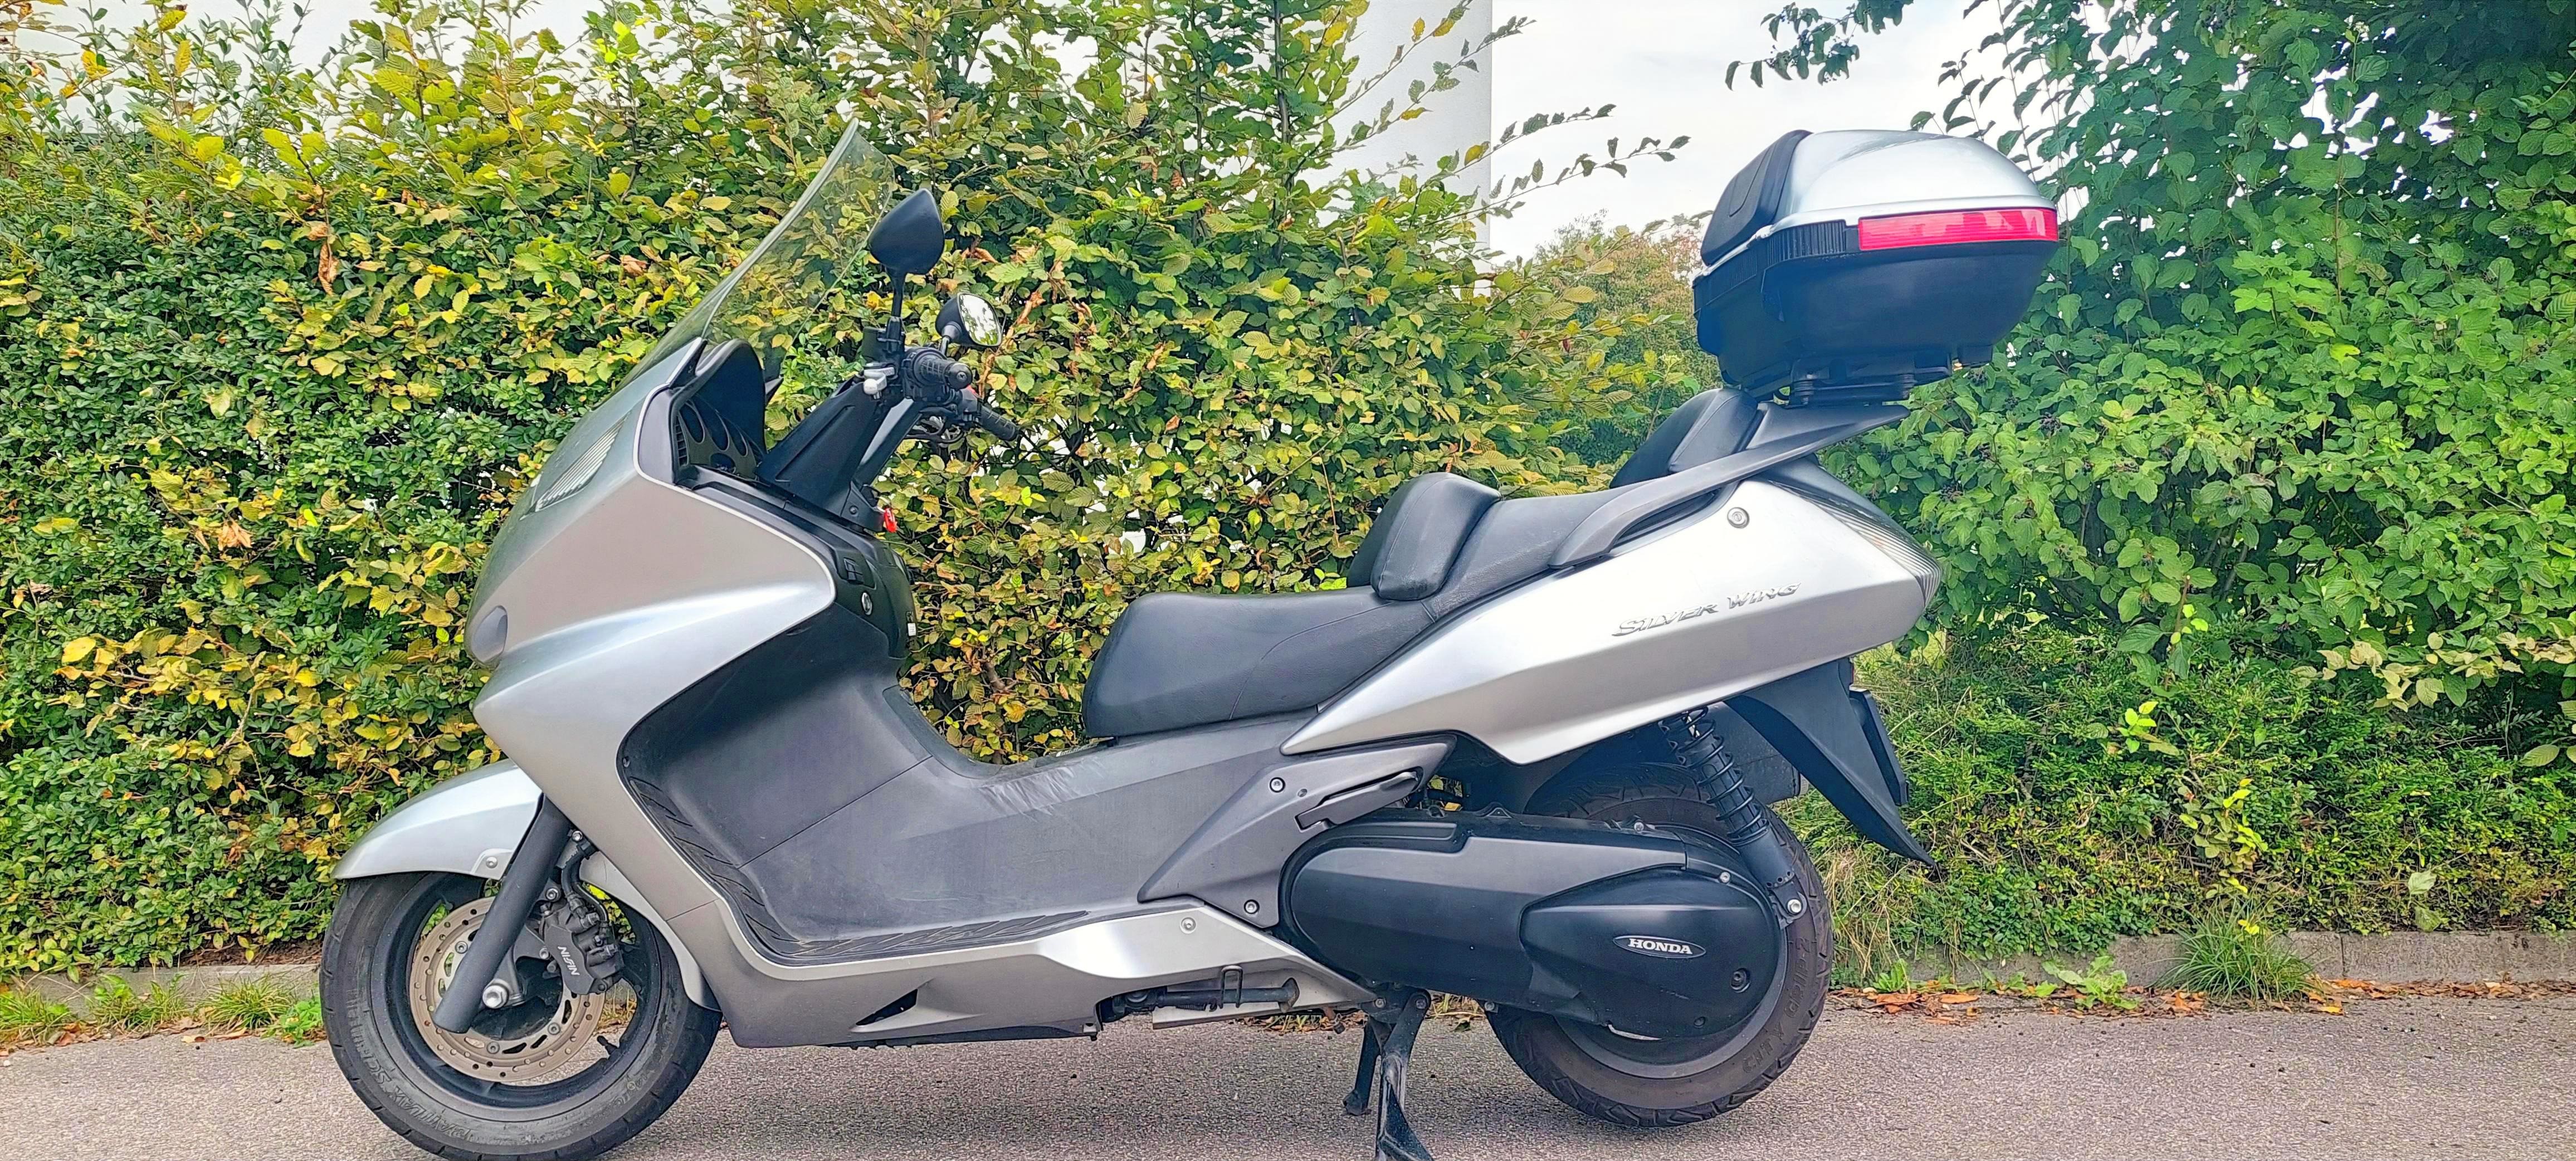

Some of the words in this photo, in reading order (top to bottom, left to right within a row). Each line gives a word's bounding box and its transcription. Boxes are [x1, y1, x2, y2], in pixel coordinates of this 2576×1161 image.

[1612, 603, 1719, 636] SILVER
[1726, 582, 1802, 609] WING
[558, 946, 580, 975] NISSIN
[1627, 938, 1692, 954] HONDA
